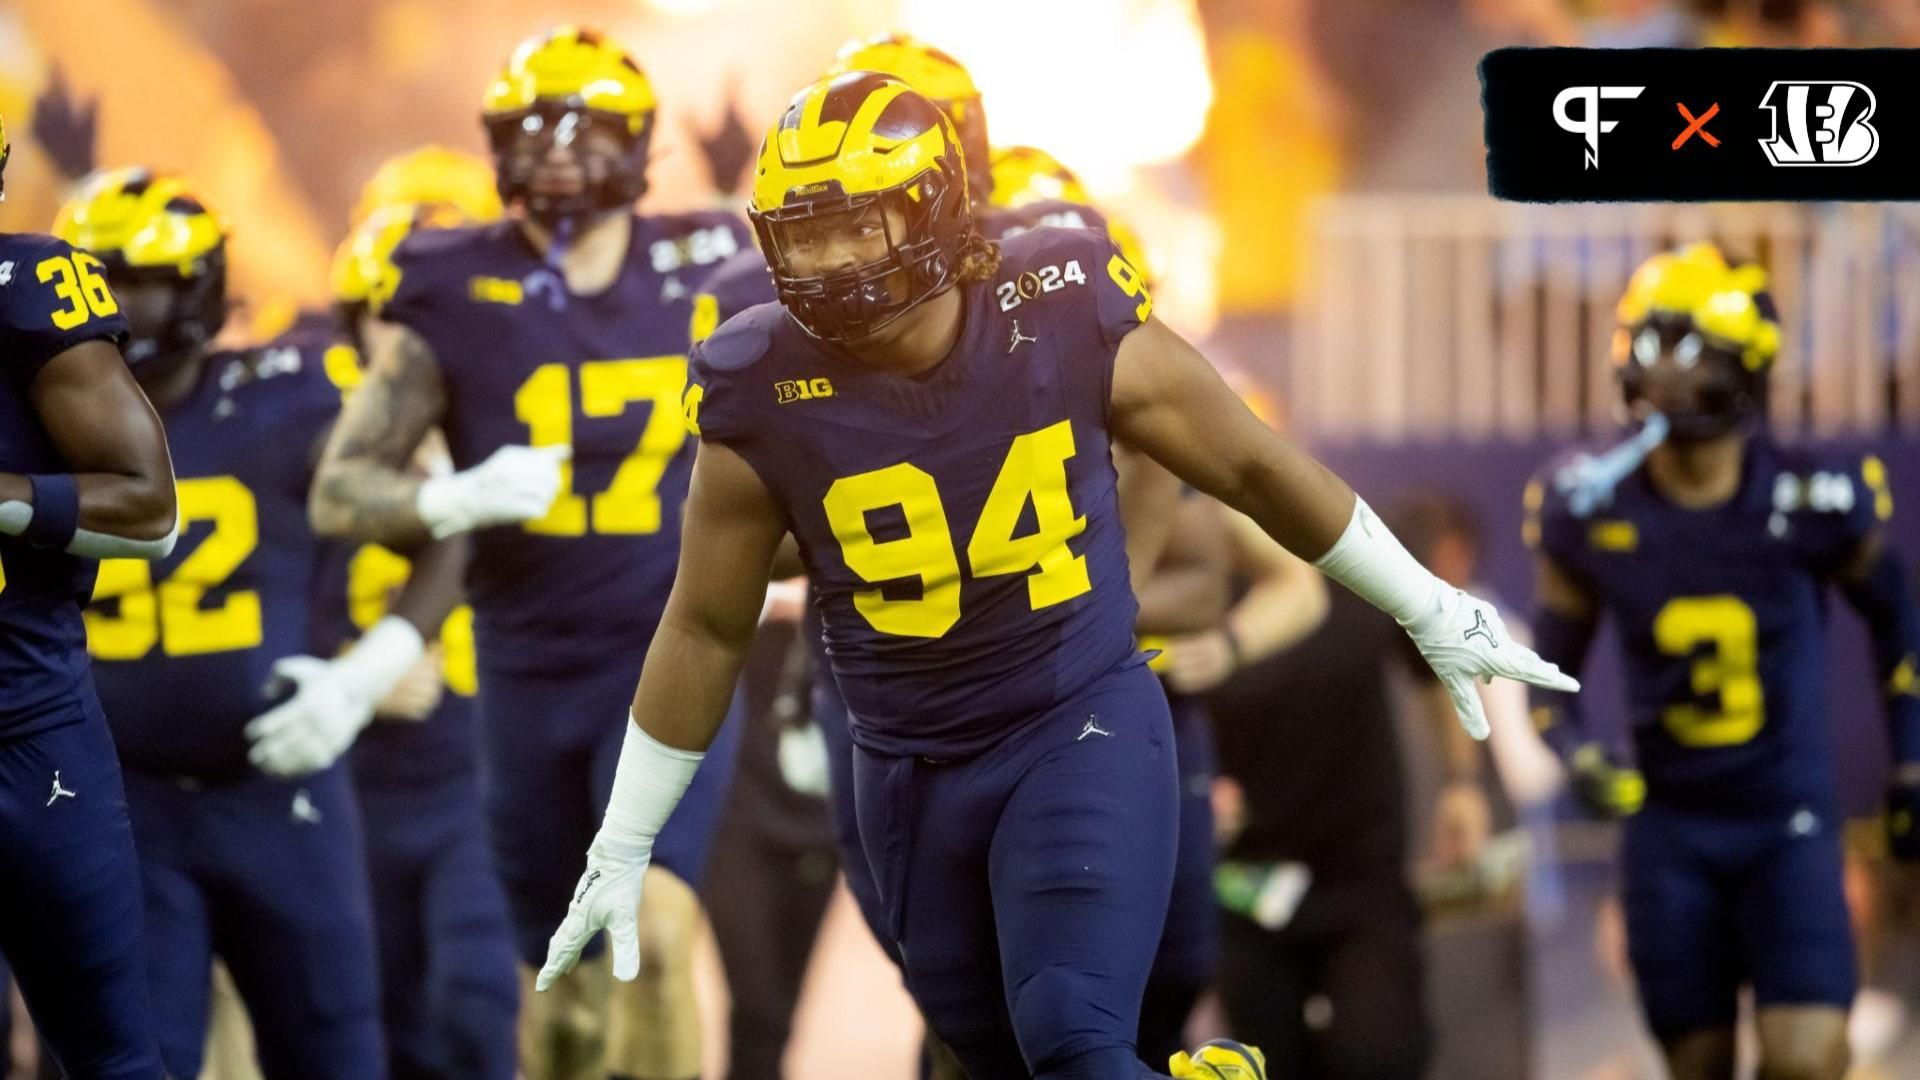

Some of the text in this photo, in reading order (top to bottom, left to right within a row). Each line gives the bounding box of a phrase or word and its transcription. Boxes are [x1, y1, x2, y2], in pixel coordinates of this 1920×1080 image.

[35, 250, 119, 331] 36
[996, 259, 1086, 312] 2024
[513, 354, 688, 538] 17
[822, 418, 1092, 639] 94
[1653, 596, 1766, 748] 3
